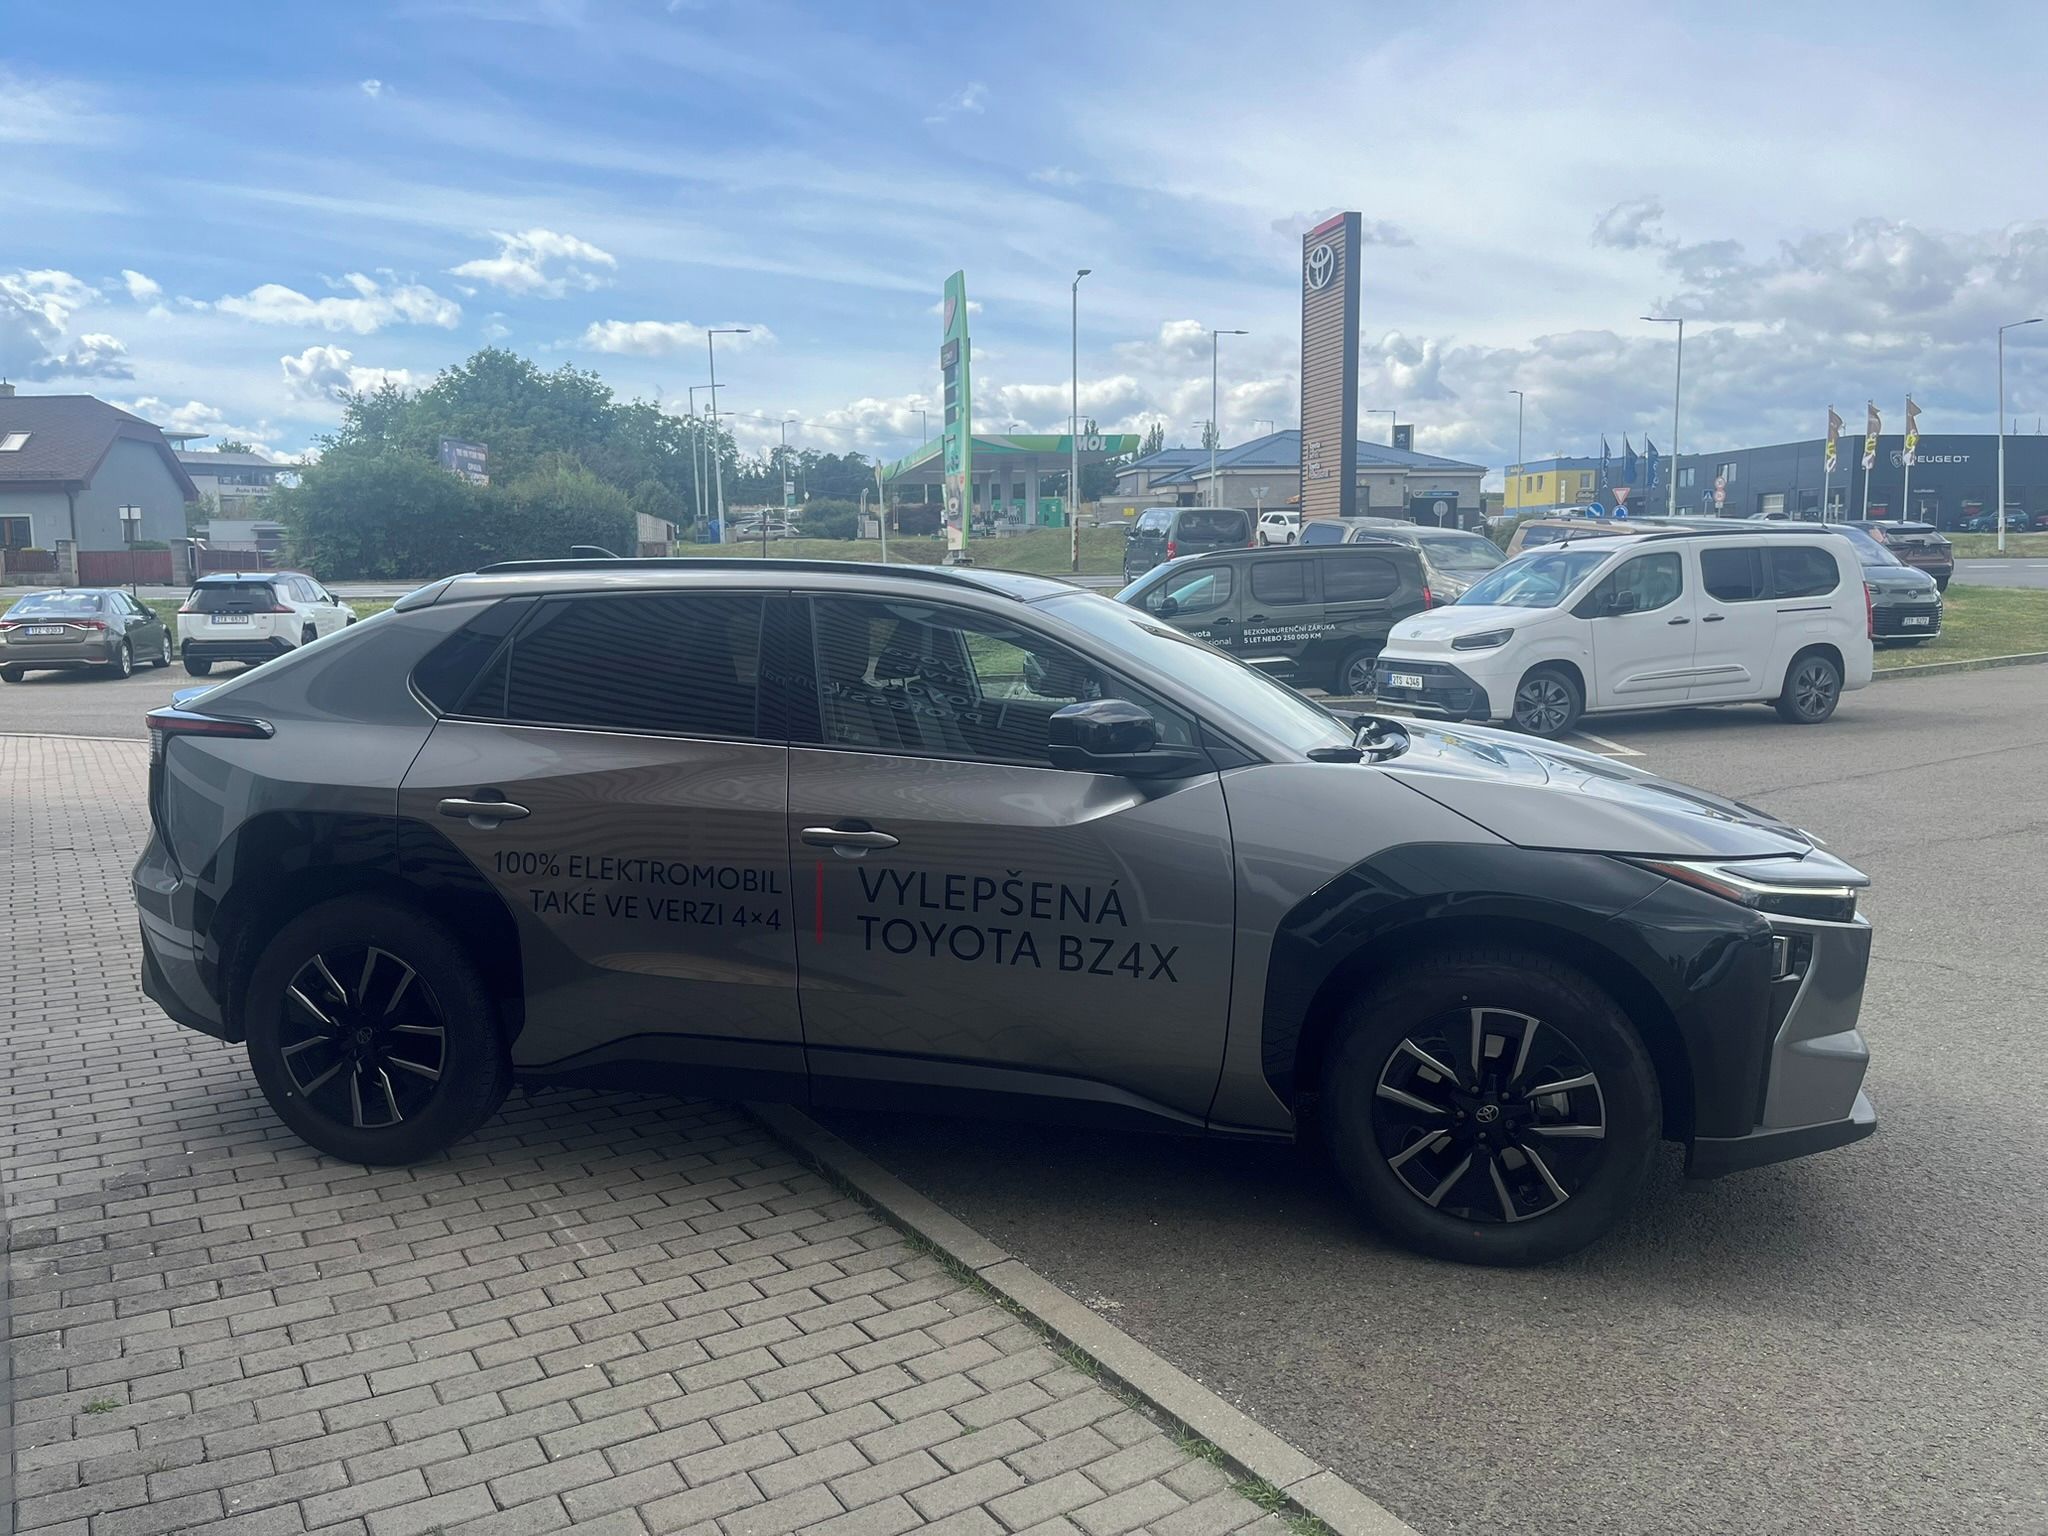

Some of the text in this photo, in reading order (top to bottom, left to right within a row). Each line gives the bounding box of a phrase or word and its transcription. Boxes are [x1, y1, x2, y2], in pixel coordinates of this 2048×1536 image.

[1076, 435, 1107, 451] MOL
[1243, 623, 1336, 636] BEZKONKURENČNÍ ZÁRUKA
[1262, 634, 1282, 642] NEBO
[494, 850, 783, 894] 100% ELEKTROMOBIL
[529, 887, 596, 916] TAKÉ
[605, 894, 638, 918] VE
[646, 897, 723, 926] VERZI
[857, 866, 1128, 927] VYLEPŠENÁ
[857, 915, 1180, 983] TOYOTA BZ4X
